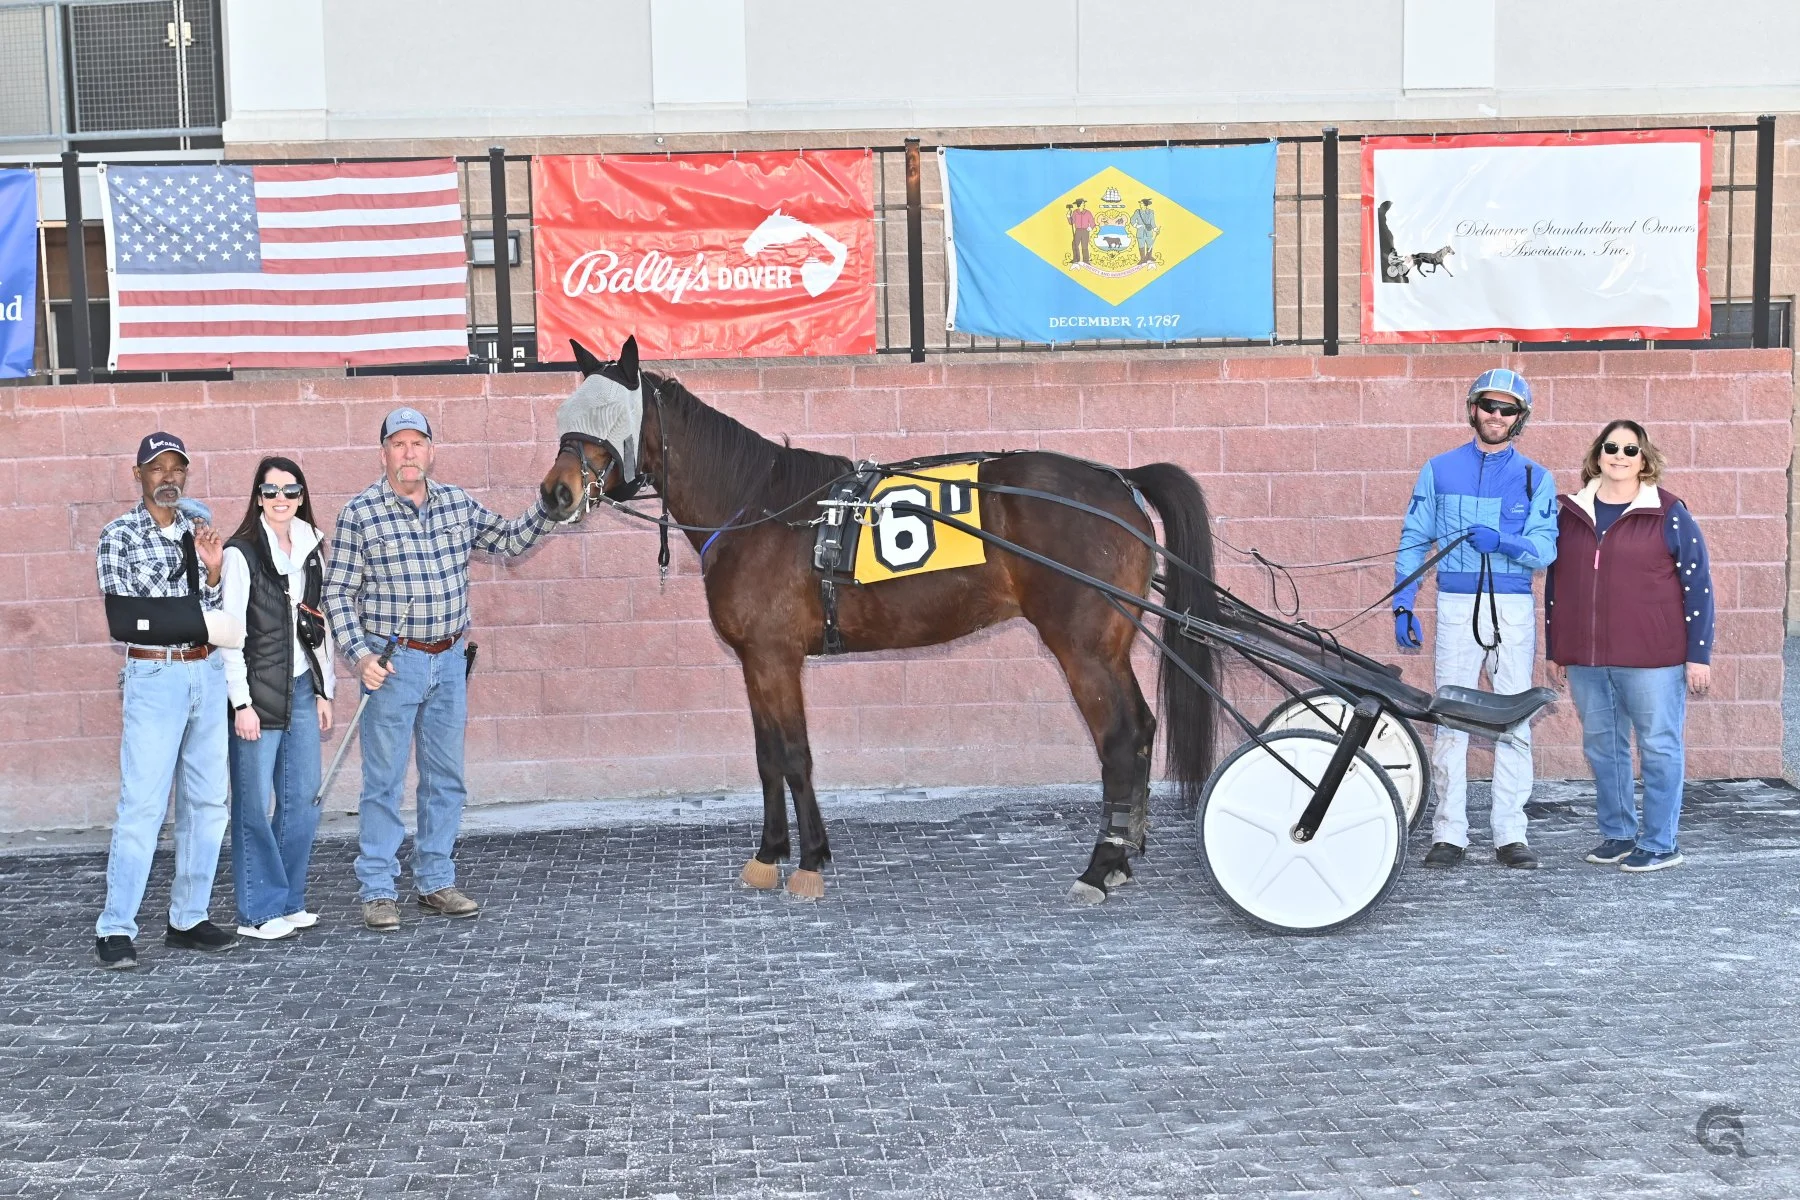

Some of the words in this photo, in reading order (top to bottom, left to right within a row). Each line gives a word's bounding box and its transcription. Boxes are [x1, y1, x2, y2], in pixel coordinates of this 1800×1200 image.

[1455, 219, 1528, 238] Delaware
[1532, 219, 1637, 239] Standardbred
[1642, 216, 1696, 235] Owners
[1593, 238, 1629, 256] Inc.
[563, 249, 709, 304] Bally's
[717, 265, 793, 291] DOVER
[1049, 316, 1132, 328] DECEMBER
[878, 488, 930, 567] 6
